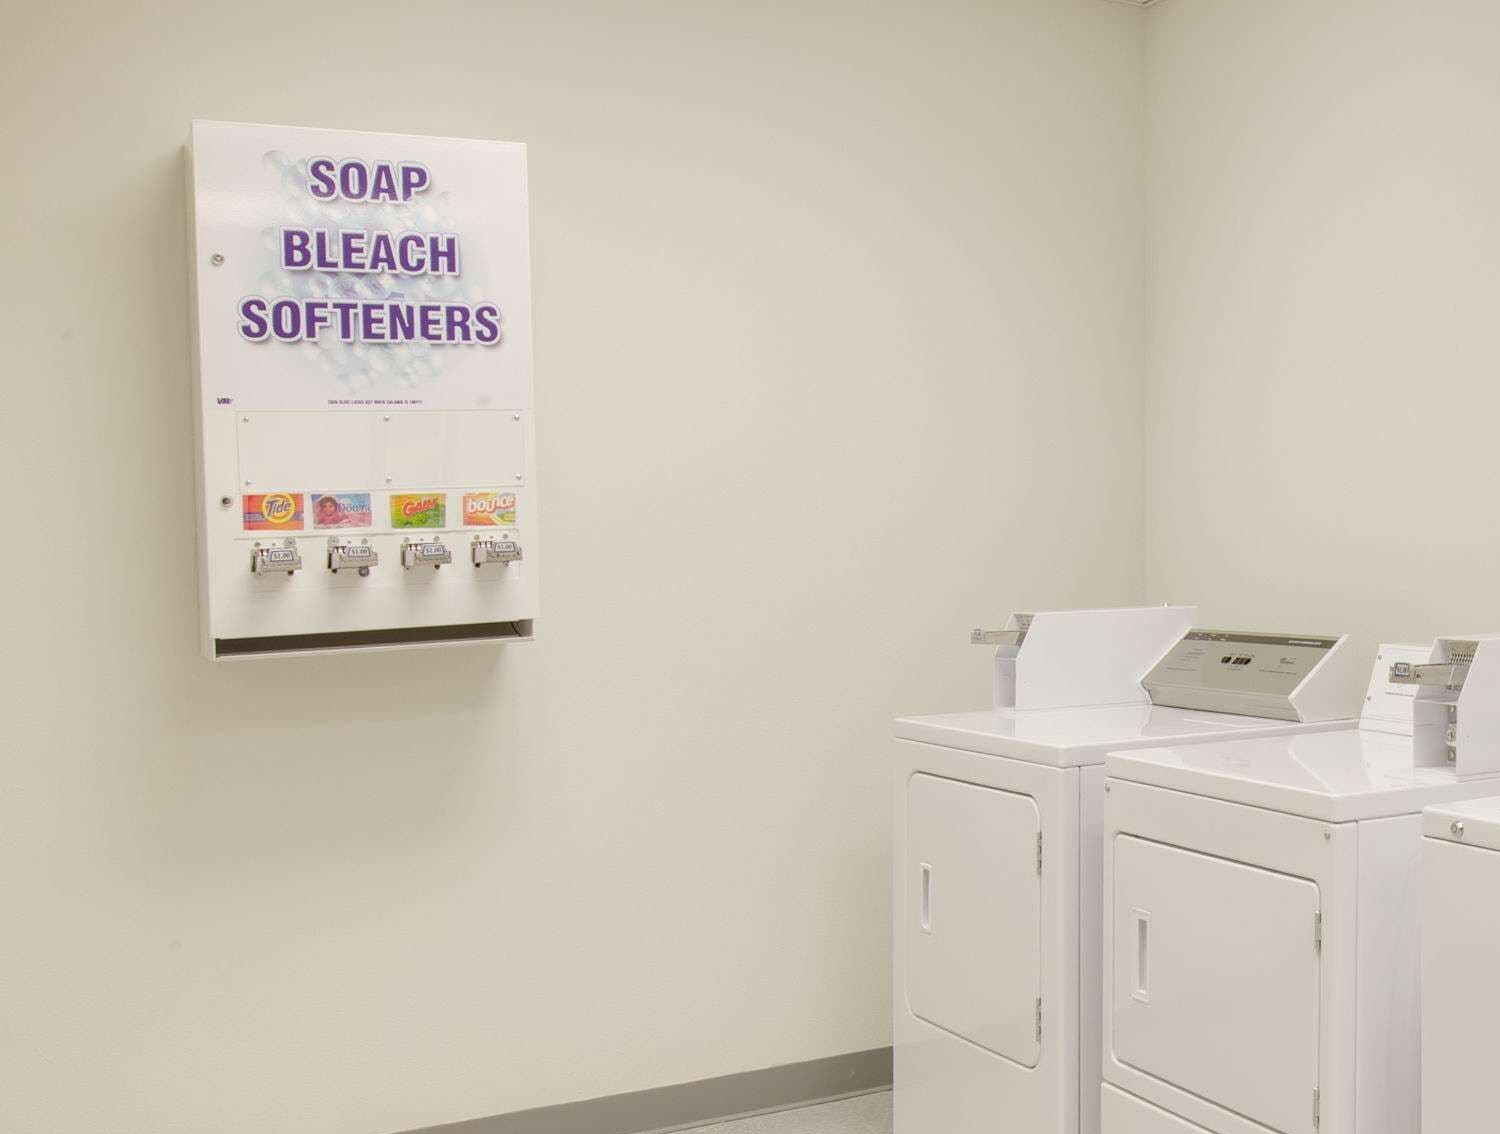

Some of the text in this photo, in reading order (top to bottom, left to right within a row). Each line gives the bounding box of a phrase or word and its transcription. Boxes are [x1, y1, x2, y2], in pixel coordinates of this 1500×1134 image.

[308, 158, 430, 203] SOAP
[280, 228, 458, 274] BLEACH
[239, 298, 501, 345] SOFTENERS
[265, 499, 292, 518] Tide
